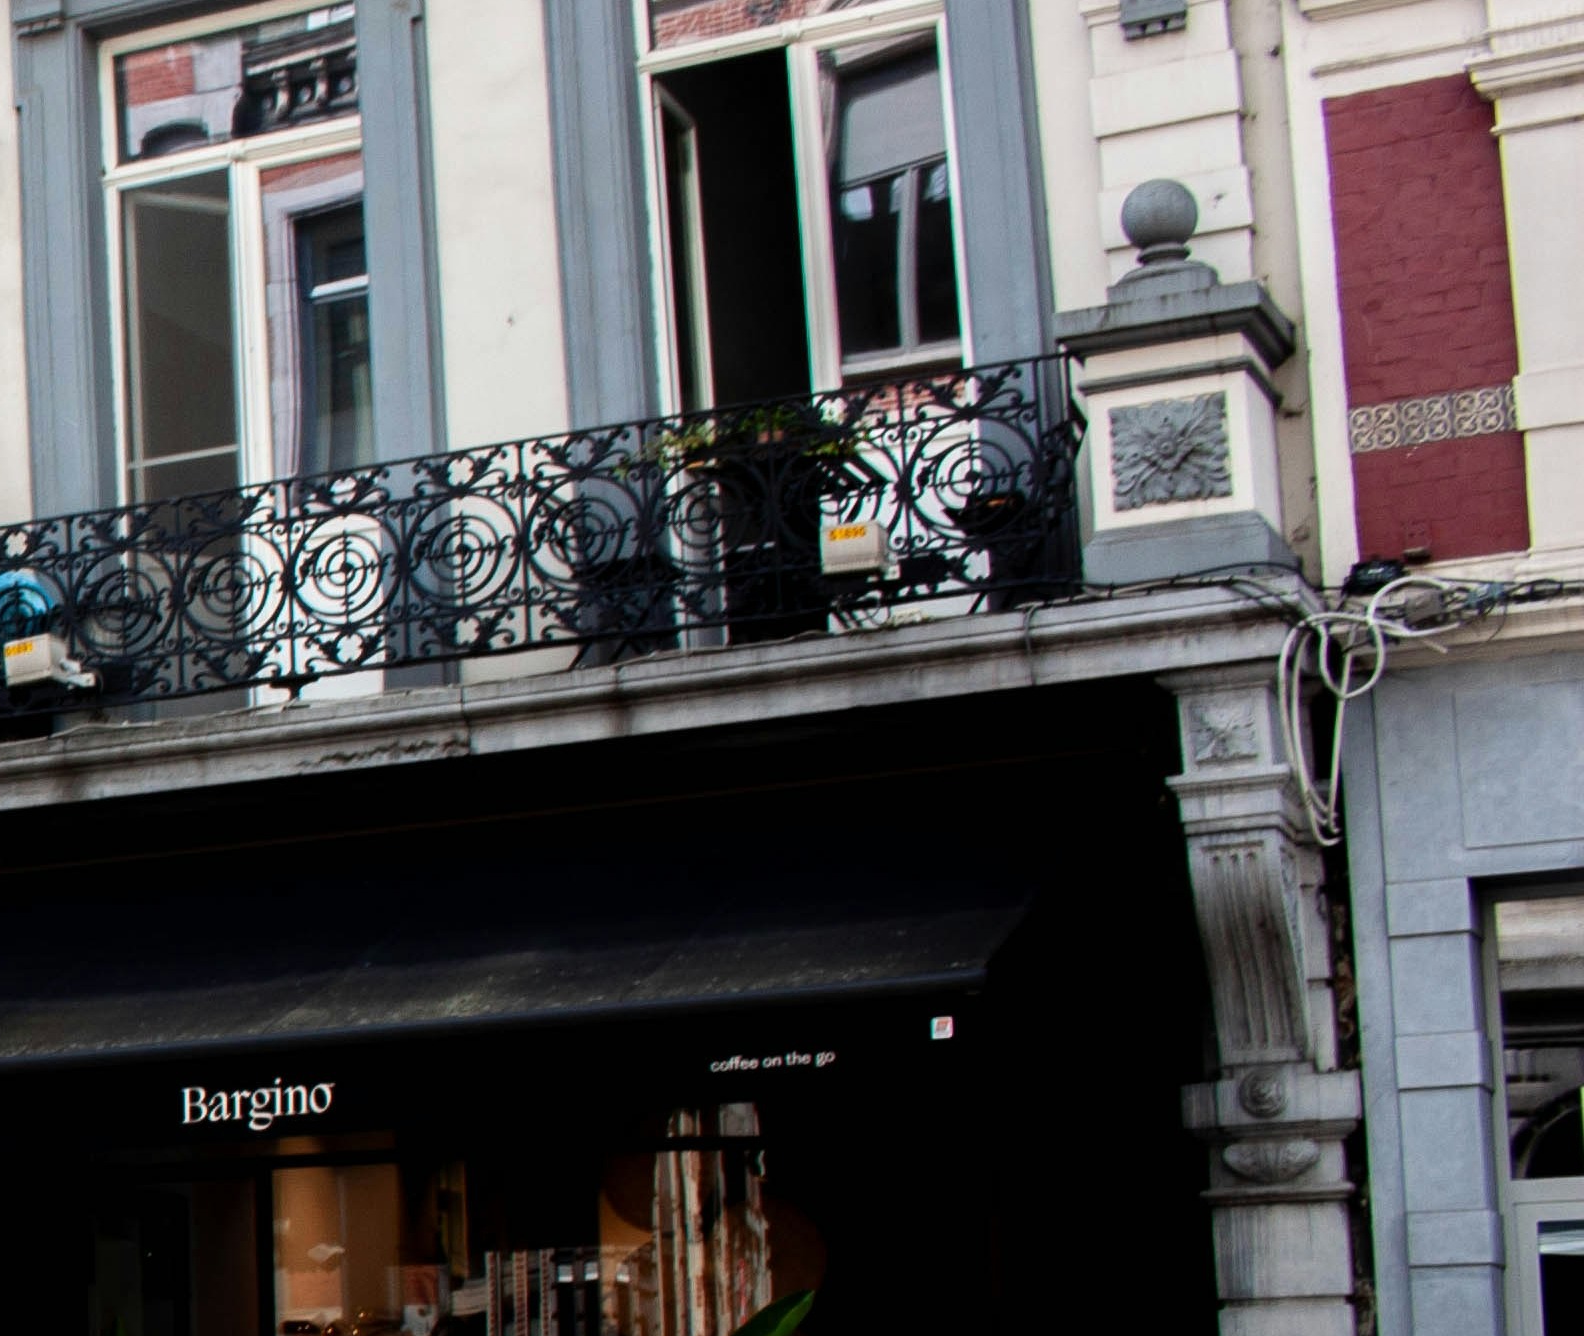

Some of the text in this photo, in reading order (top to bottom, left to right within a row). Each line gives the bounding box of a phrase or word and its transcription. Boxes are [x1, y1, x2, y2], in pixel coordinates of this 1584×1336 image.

[709, 1051, 837, 1073] coffee on the go
[182, 1076, 336, 1131] Bargino
